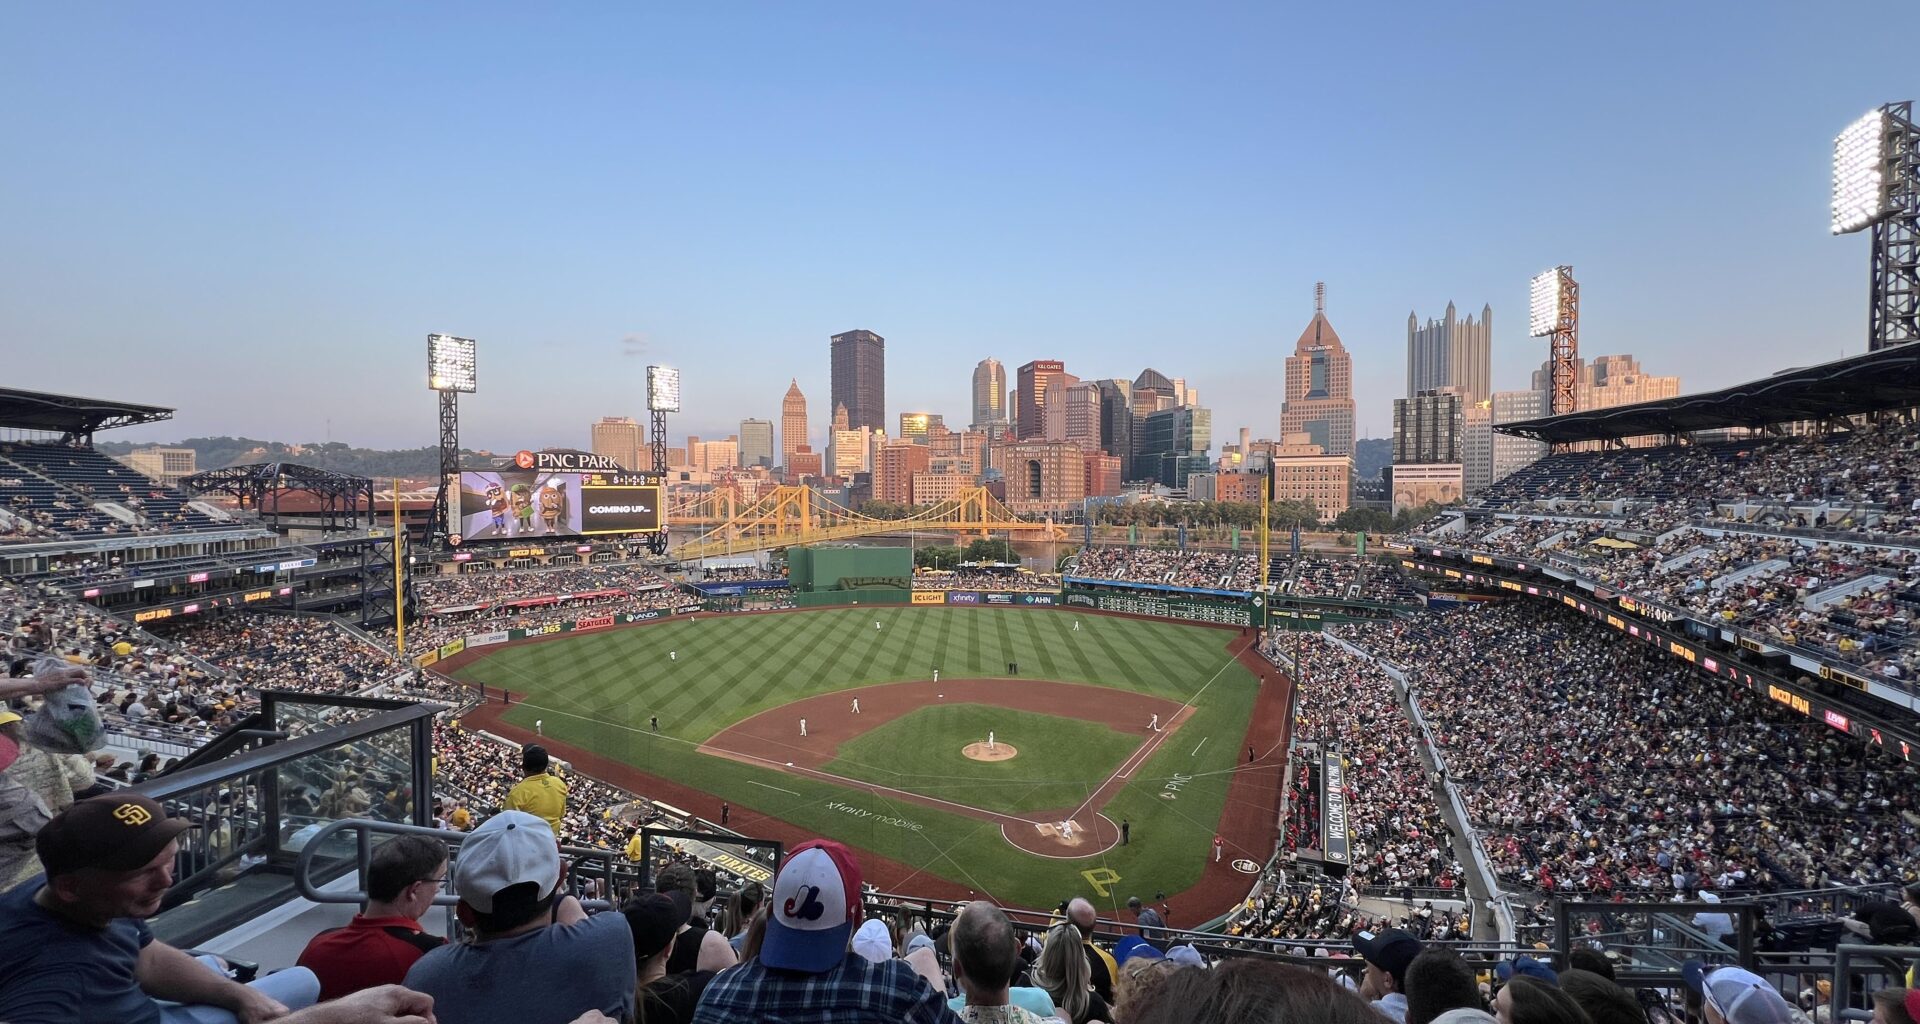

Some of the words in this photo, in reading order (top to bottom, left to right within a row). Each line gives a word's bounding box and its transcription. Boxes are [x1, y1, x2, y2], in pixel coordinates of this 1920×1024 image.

[536, 453, 574, 468] PNC
[578, 454, 619, 469] PARK
[588, 506, 630, 514] COMING
[952, 594, 975, 602] xfinity
[1034, 596, 1051, 604] AHN
[634, 611, 659, 620] VANDA
[526, 624, 561, 637] bet365
[578, 618, 612, 630] SEATGEEK
[1165, 772, 1192, 792] PNC
[1328, 792, 1342, 802] TO
[112, 804, 152, 826] SD
[826, 802, 872, 818] xfinity
[872, 814, 923, 831] mobile
[1328, 804, 1345, 839] WELCOME
[712, 854, 771, 881] PIRATES
[1080, 867, 1122, 897] P
